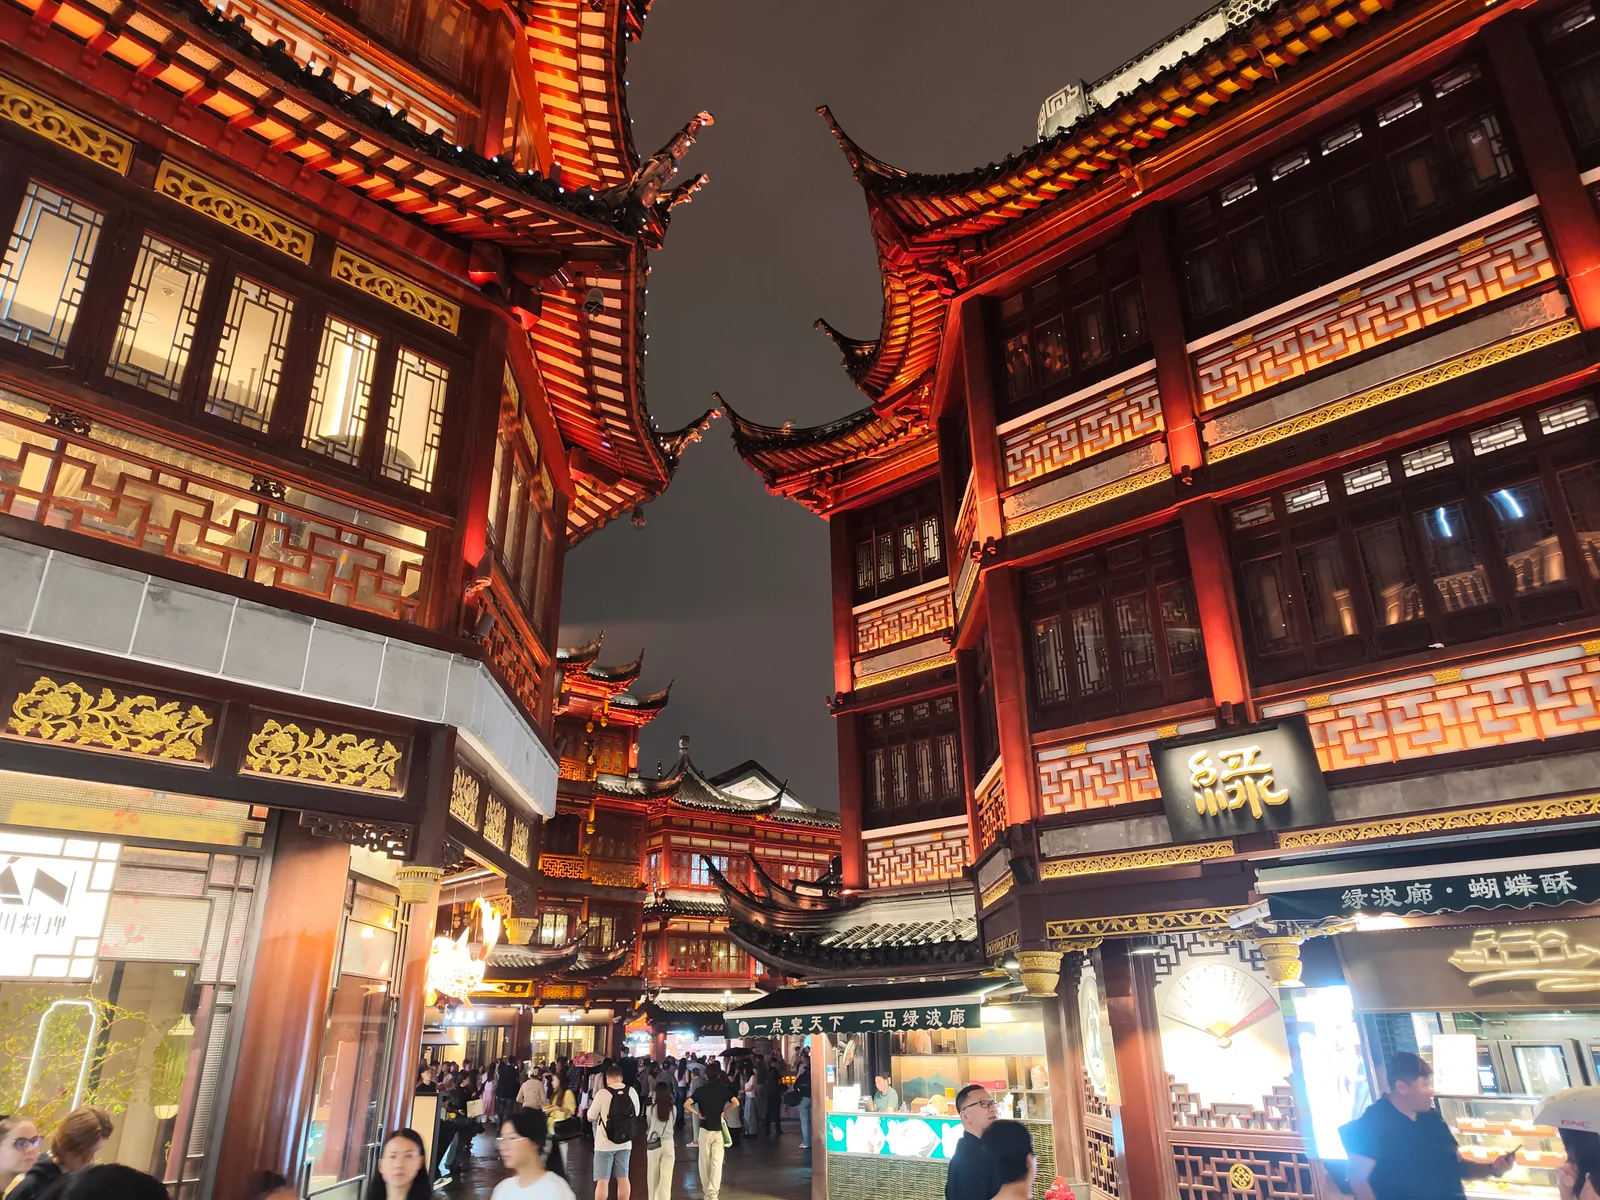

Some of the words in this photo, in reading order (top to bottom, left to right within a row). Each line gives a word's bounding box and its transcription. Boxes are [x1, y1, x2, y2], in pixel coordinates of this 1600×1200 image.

[754, 1016, 845, 1033] 一点宴天下
[859, 1008, 966, 1028] 一品绿波廊
